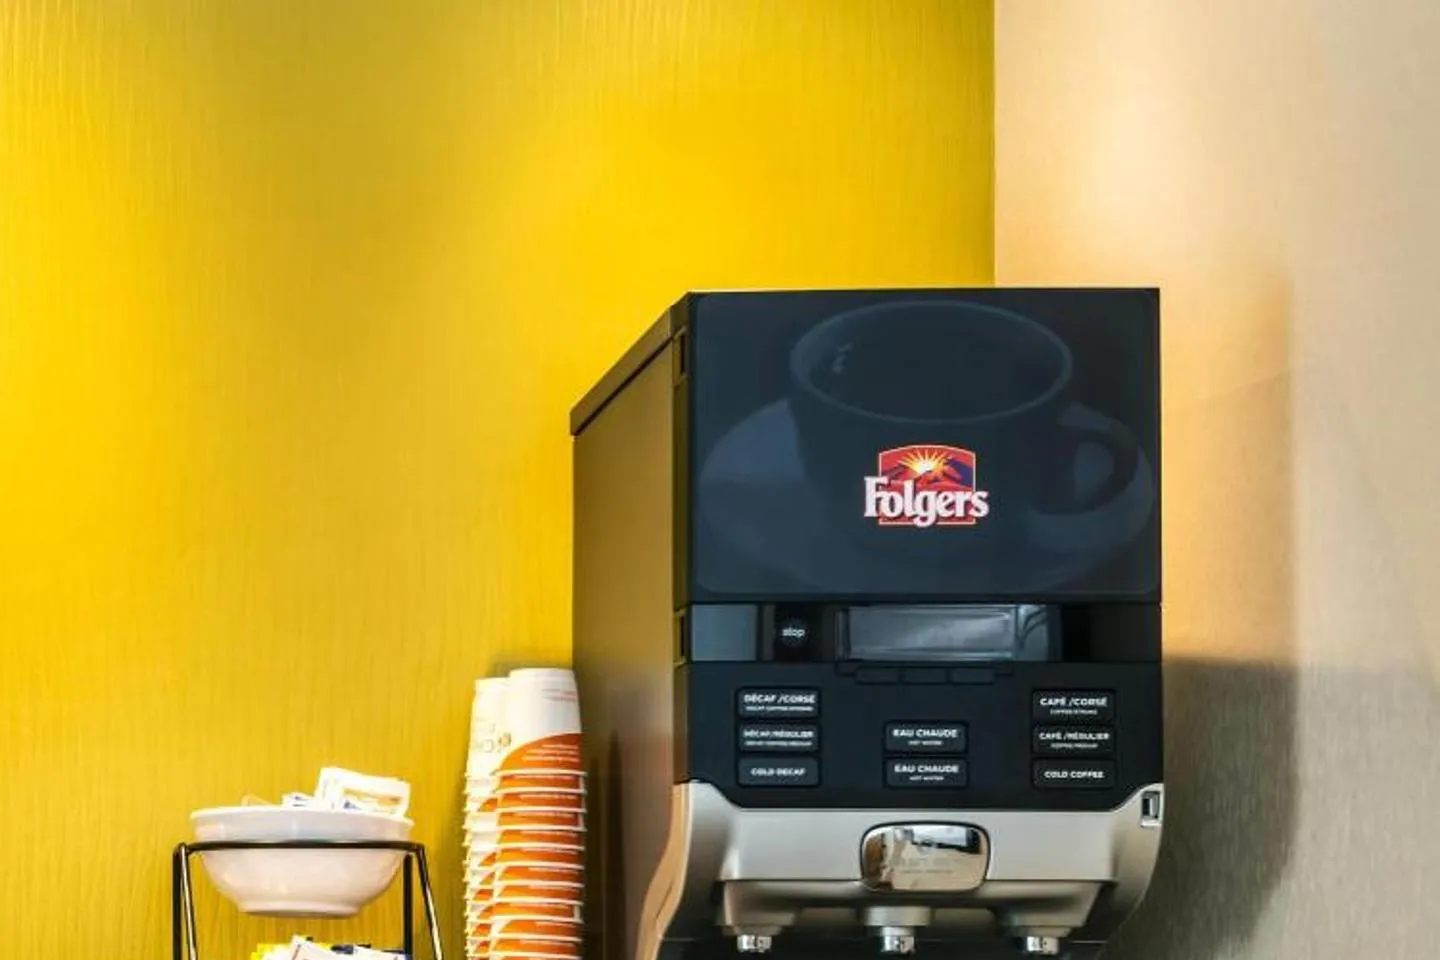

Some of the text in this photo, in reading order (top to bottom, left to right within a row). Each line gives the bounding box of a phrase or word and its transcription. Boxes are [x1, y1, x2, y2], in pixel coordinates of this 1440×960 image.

[863, 476, 990, 527] Folgers
[782, 626, 806, 639] stop
[892, 728, 959, 738] EAU CHAUDE
[894, 763, 960, 773] EAU CHAUDE
[1043, 770, 1105, 779] COLD COFFEE
